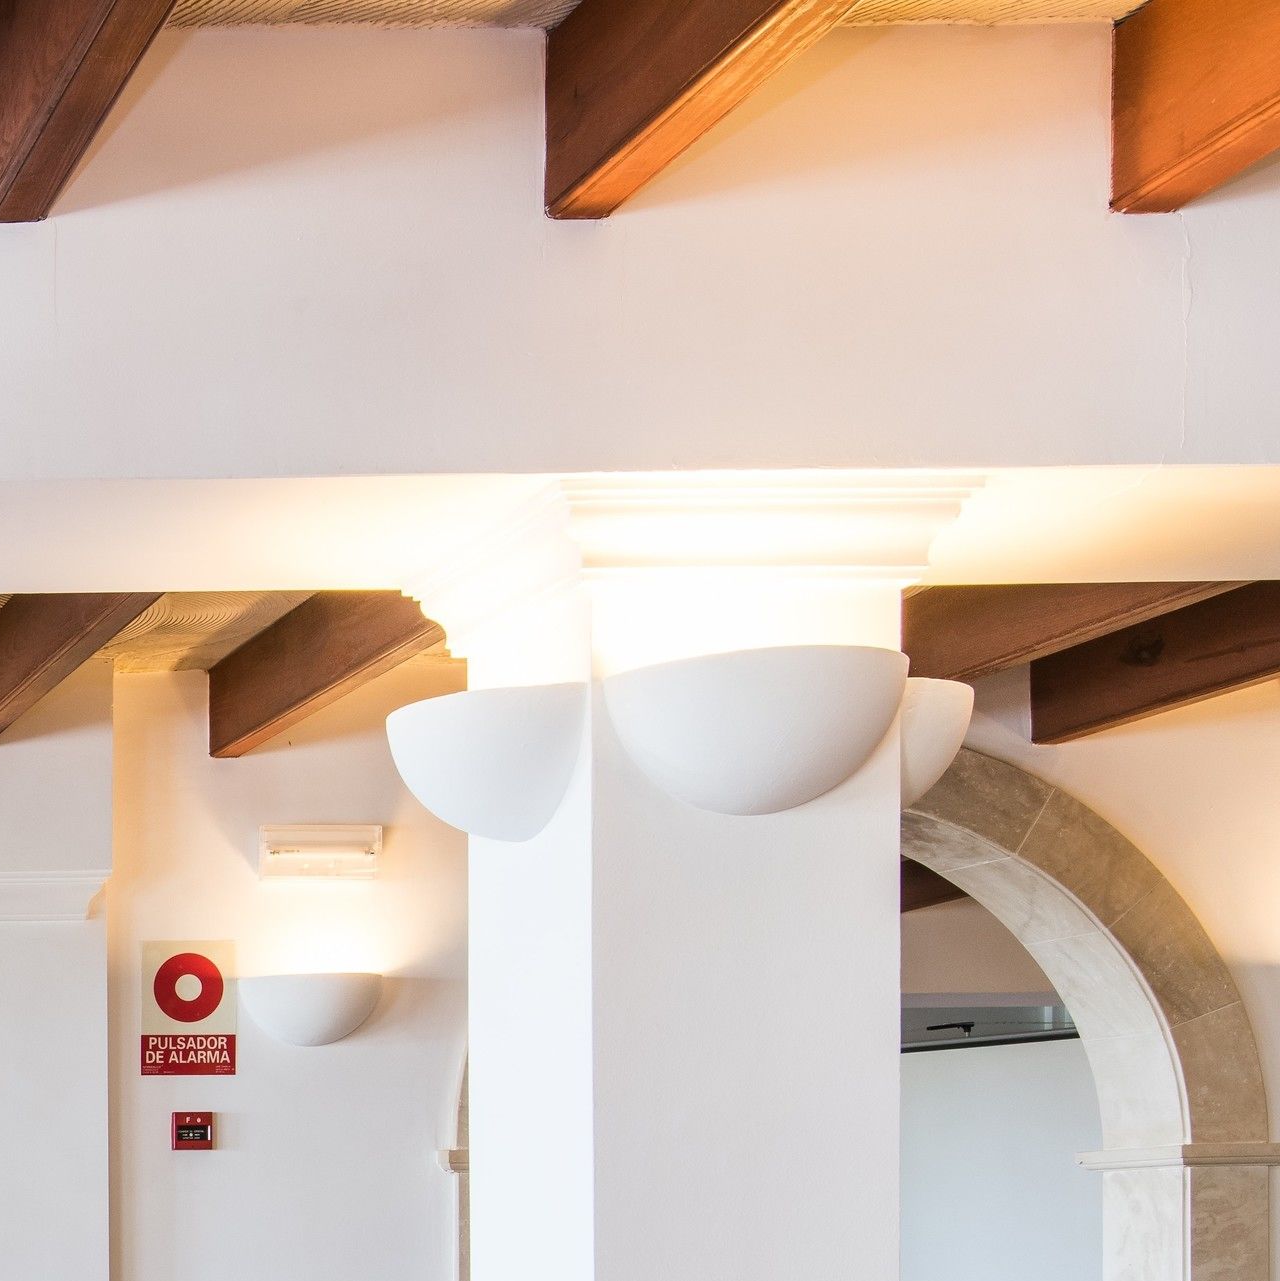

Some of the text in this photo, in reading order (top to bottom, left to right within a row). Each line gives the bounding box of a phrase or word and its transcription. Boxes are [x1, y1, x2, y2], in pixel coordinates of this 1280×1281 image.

[149, 1036, 227, 1050] PULSADOR
[145, 1050, 231, 1064] DE ALARMA
